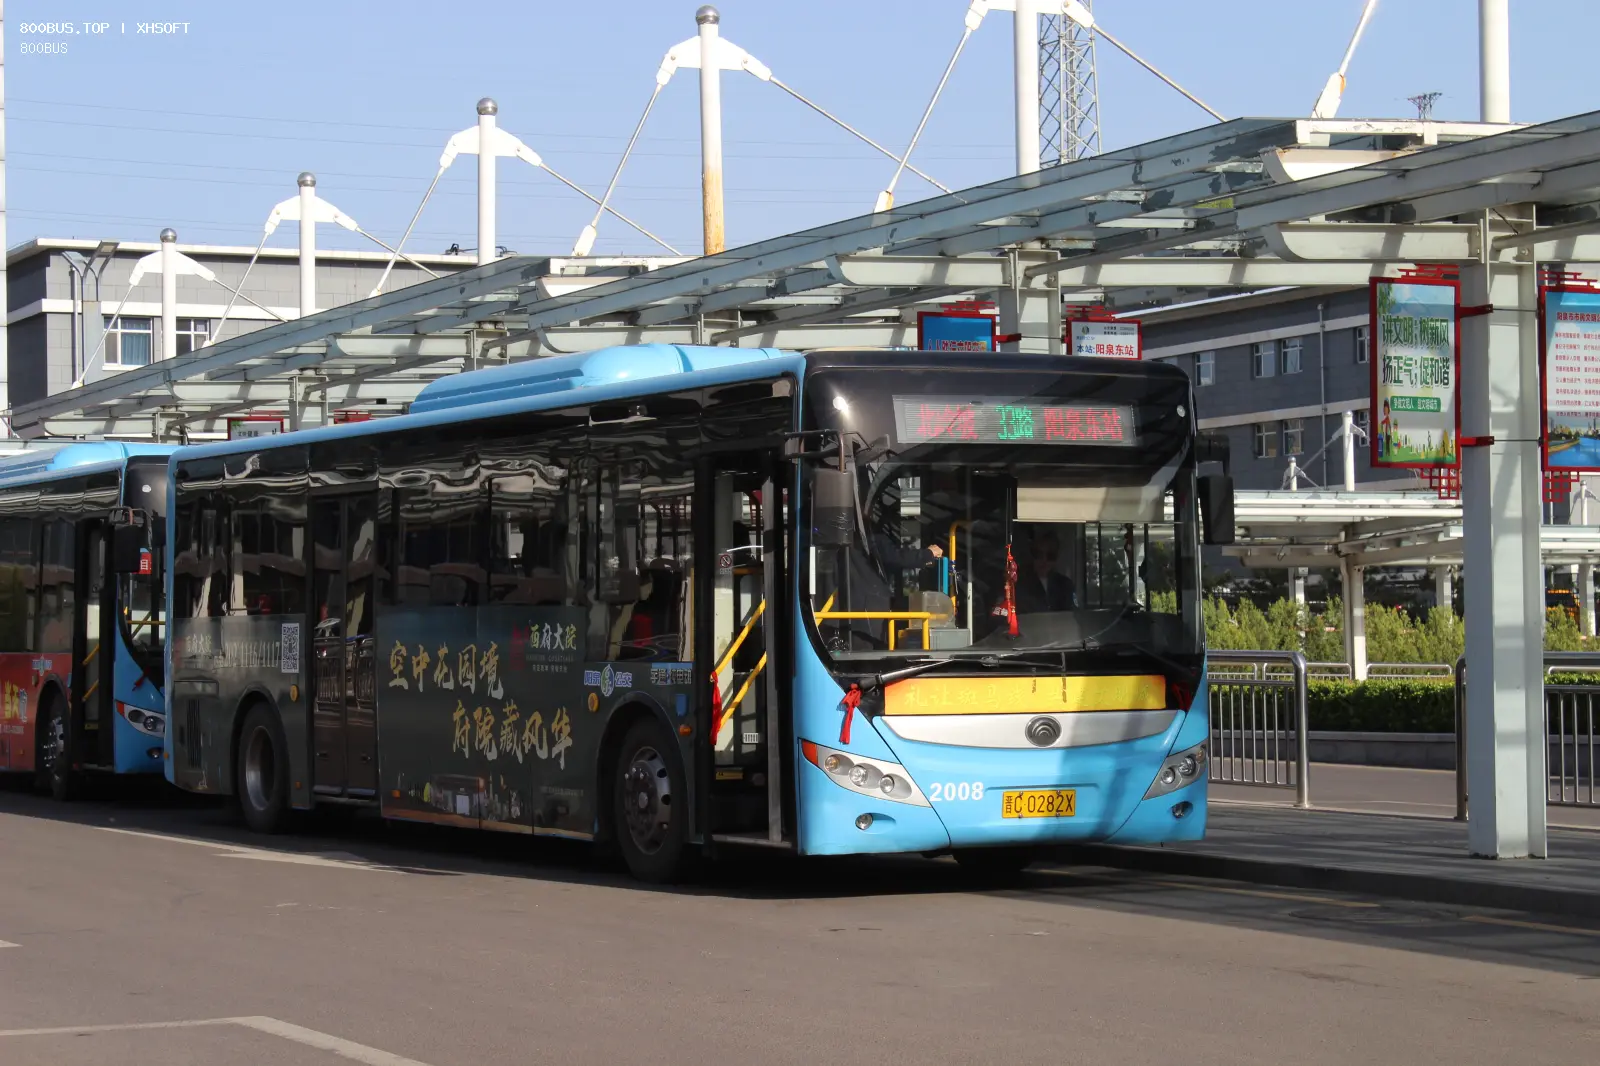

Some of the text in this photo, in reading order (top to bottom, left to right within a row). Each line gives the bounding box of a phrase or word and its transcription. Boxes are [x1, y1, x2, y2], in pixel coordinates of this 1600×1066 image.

[1043, 406, 1123, 441] 阳泉东站
[530, 622, 577, 651] 西府大院
[583, 670, 633, 687] 阳泉 公交
[452, 700, 574, 770] 府院藏风华
[929, 781, 984, 802] 2008
